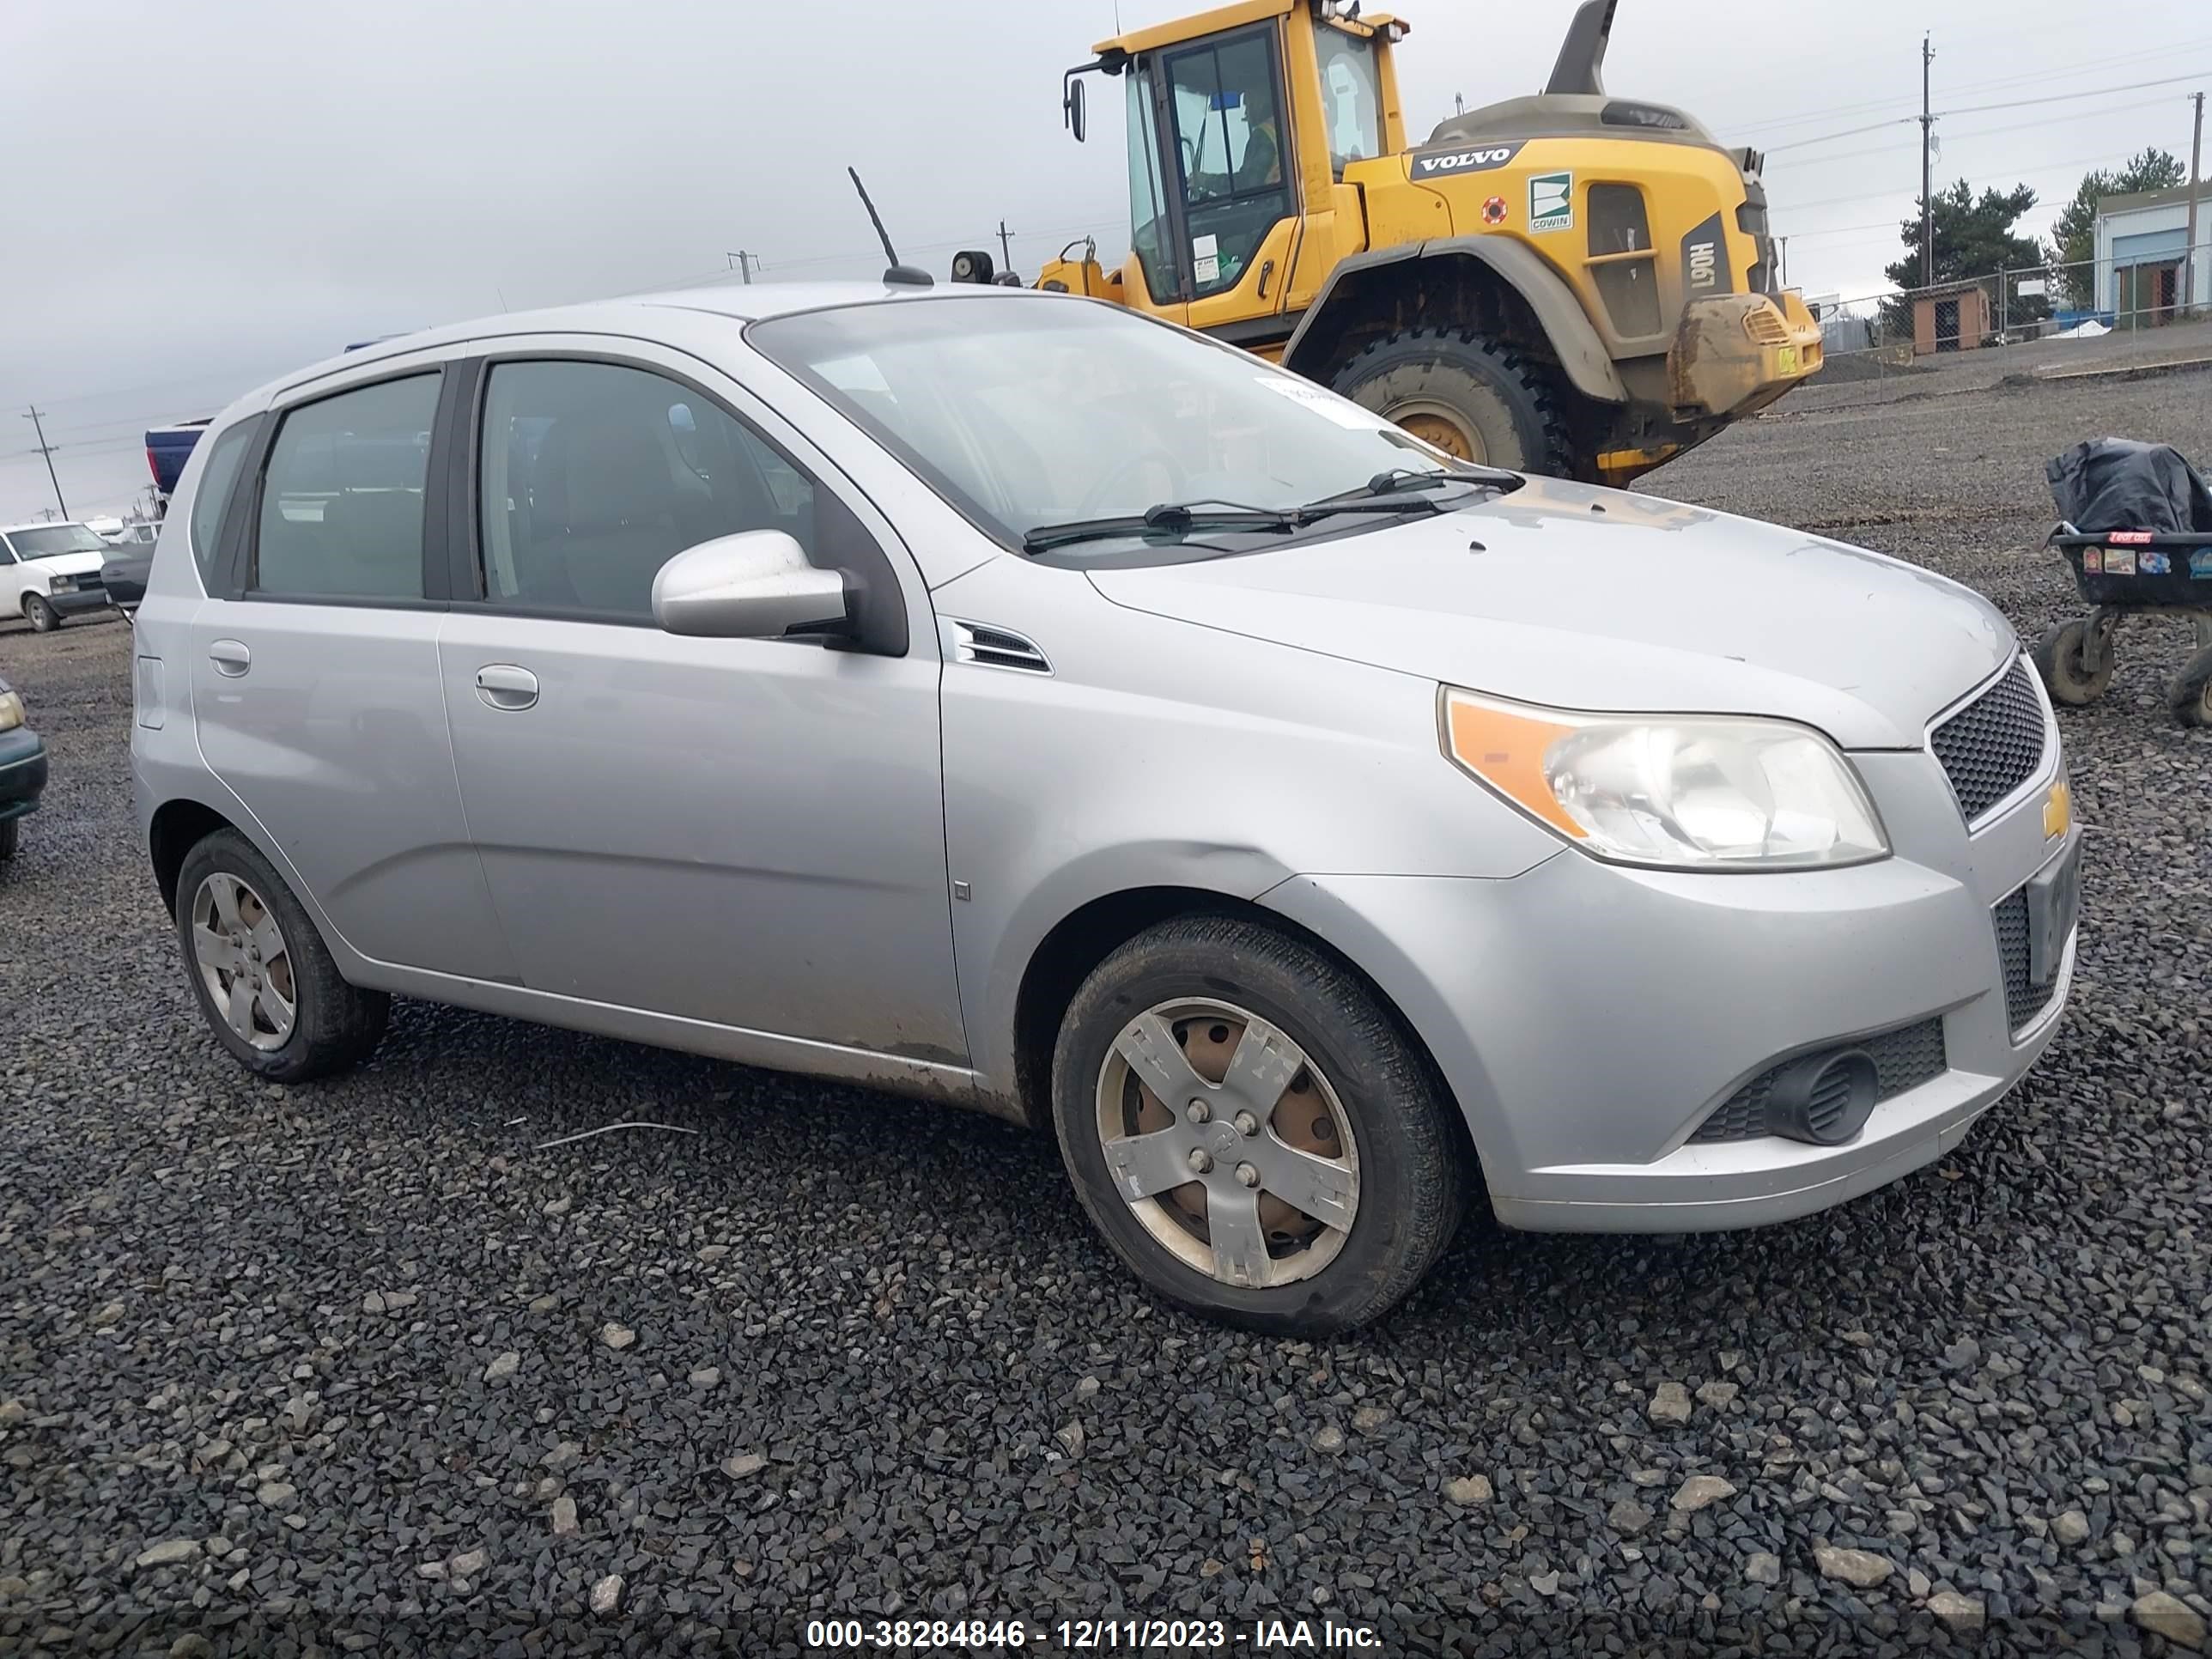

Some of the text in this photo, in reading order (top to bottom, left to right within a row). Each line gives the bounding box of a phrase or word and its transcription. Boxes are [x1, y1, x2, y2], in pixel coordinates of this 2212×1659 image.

[1420, 149, 1510, 171] VOLVO
[1533, 216, 1568, 228] COWIN
[1689, 241, 1716, 289] L90H
